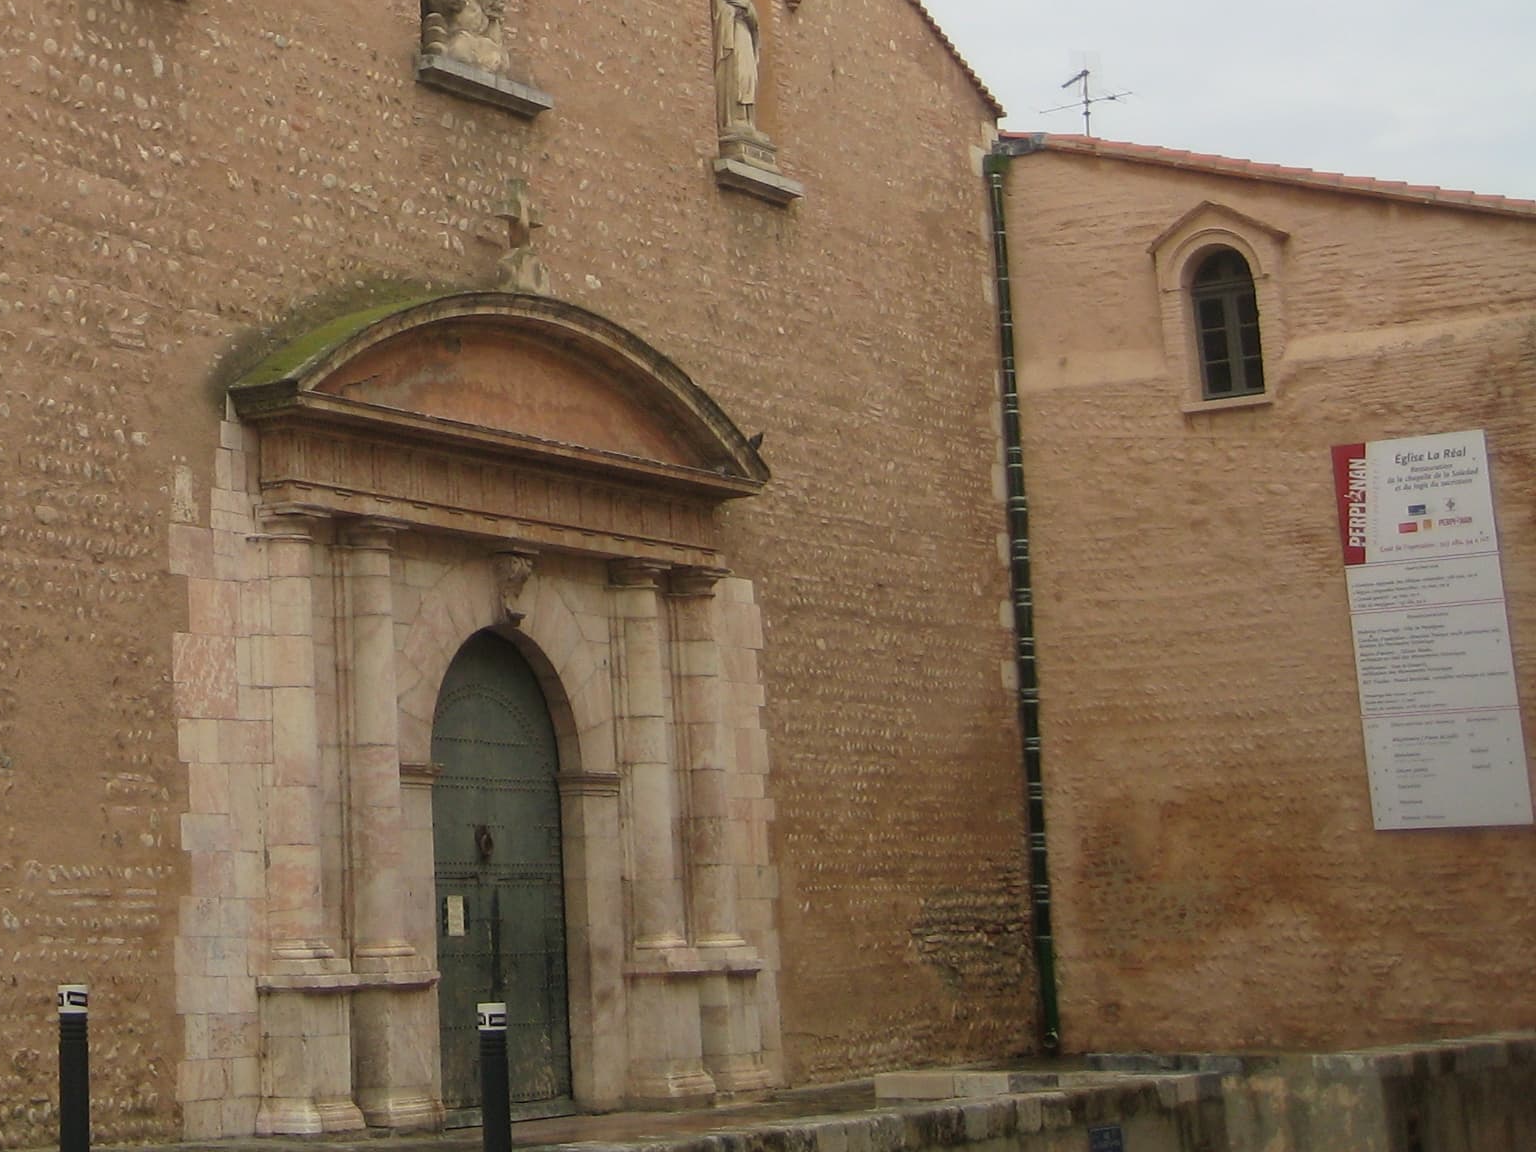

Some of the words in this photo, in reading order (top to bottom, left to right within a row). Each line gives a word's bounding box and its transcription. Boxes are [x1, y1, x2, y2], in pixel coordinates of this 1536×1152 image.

[1394, 452, 1424, 466] Eglise
[1427, 450, 1440, 460] La
[1443, 446, 1467, 458] Réal
[1345, 458, 1366, 547] PERPIGNAN
